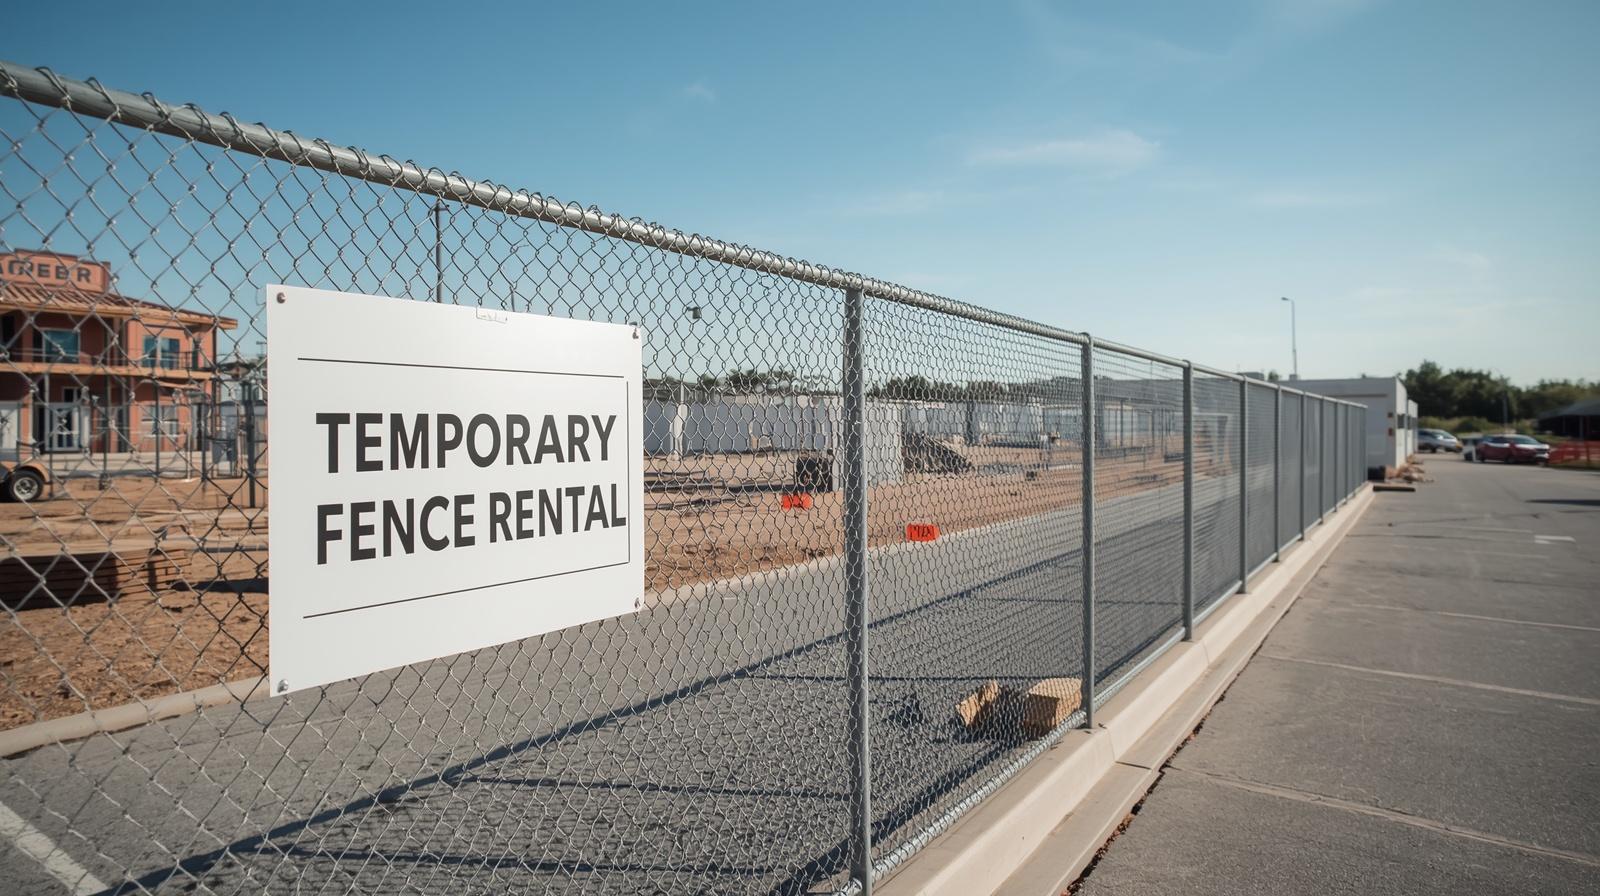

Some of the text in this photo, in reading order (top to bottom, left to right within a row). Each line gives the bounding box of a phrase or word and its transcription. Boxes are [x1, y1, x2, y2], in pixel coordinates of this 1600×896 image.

[316, 413, 617, 473] TEMPORARY
[318, 484, 626, 564] FENCE RENTAL
